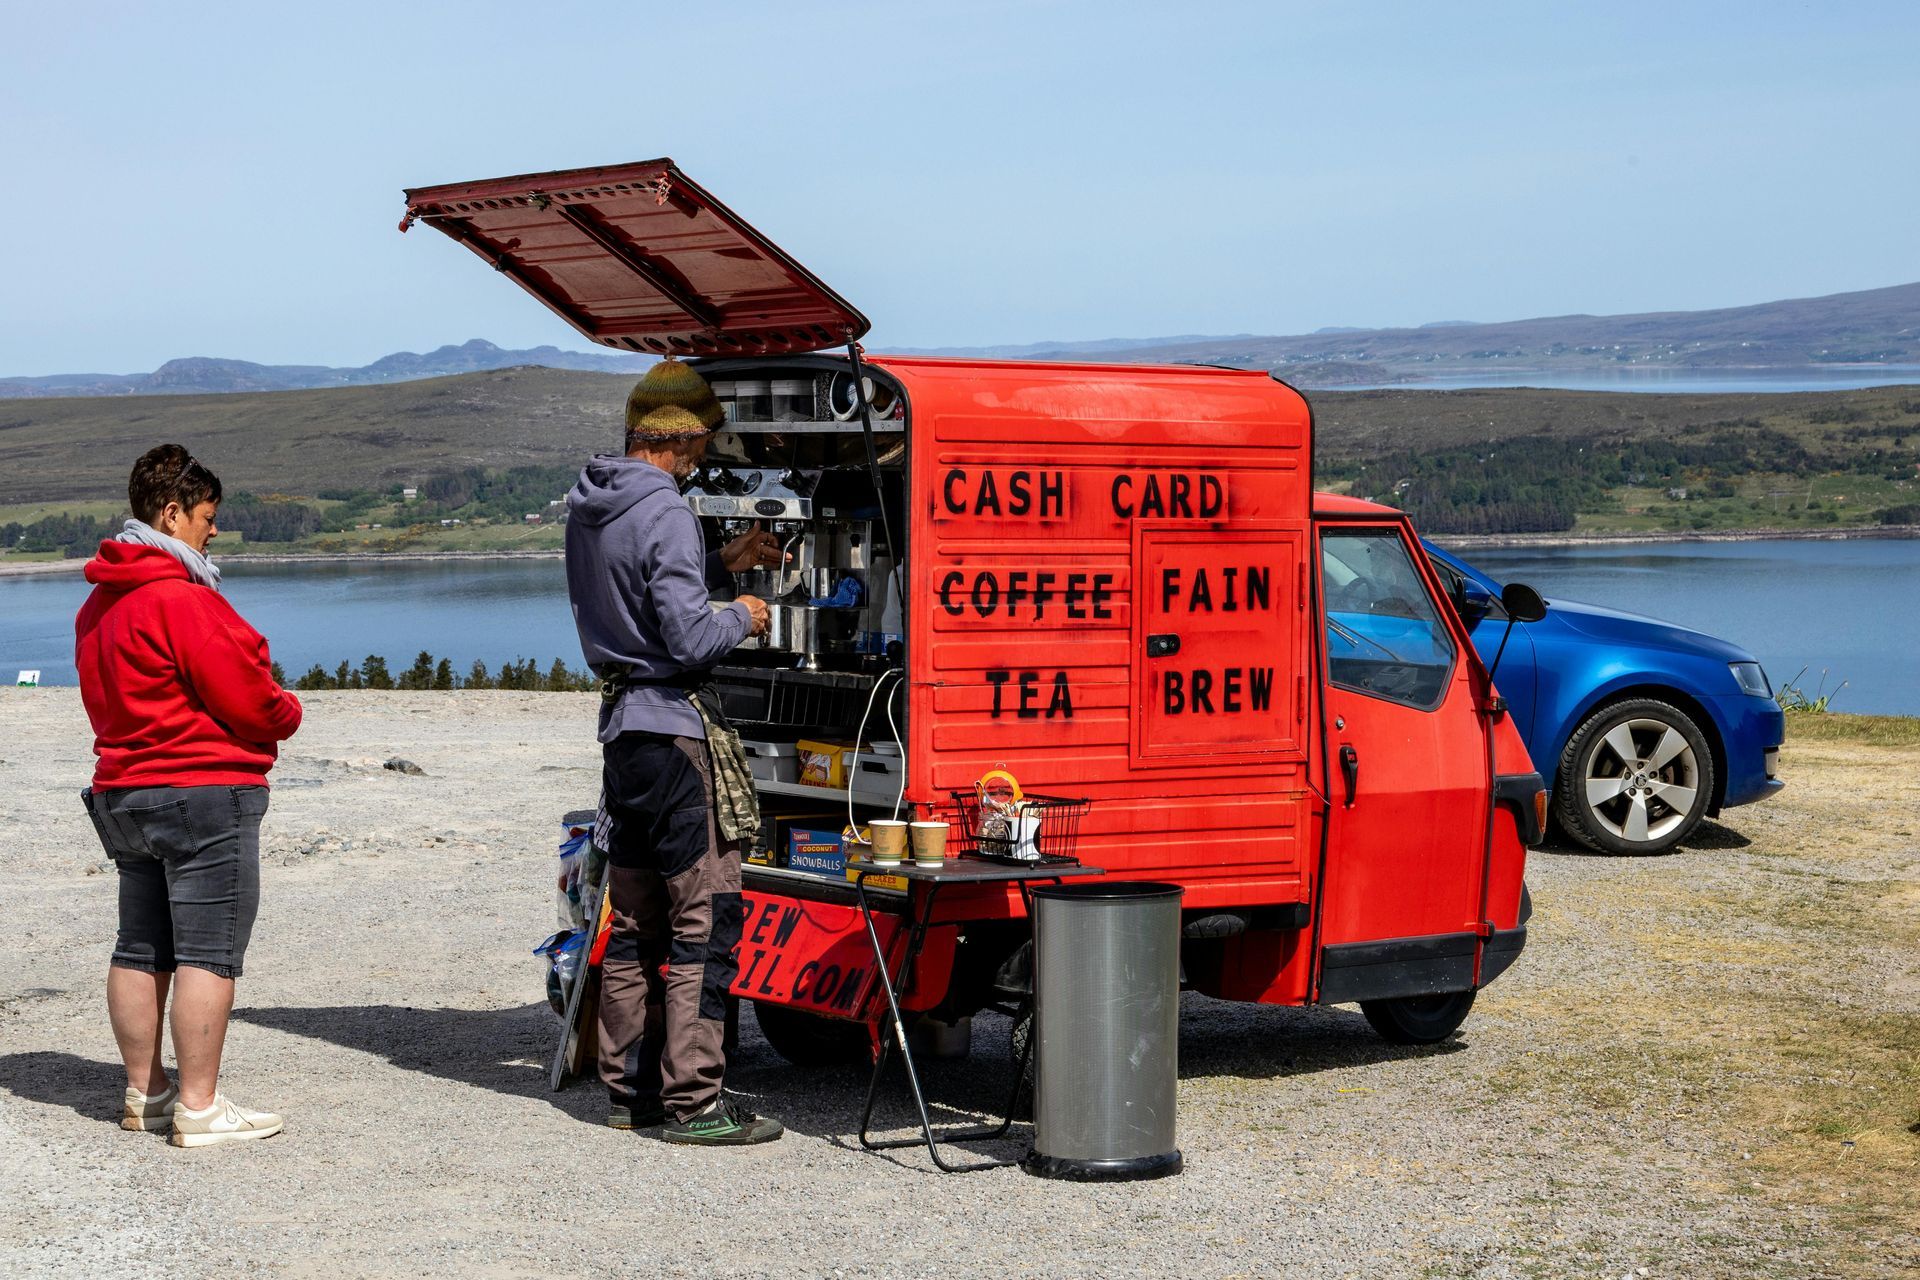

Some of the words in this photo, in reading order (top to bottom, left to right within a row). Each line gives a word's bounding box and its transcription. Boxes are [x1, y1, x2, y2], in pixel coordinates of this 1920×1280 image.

[943, 469, 1063, 517] CASH
[1111, 474, 1223, 518] CARD
[940, 571, 1114, 620] COFFEE
[1162, 566, 1270, 613] FAIN
[985, 671, 1074, 719] TEA
[1164, 667, 1274, 715] BREW
[791, 854, 841, 871] SNOWBALLS
[733, 945, 865, 1011] IL.COM
[689, 1120, 720, 1128] FEIYUE
